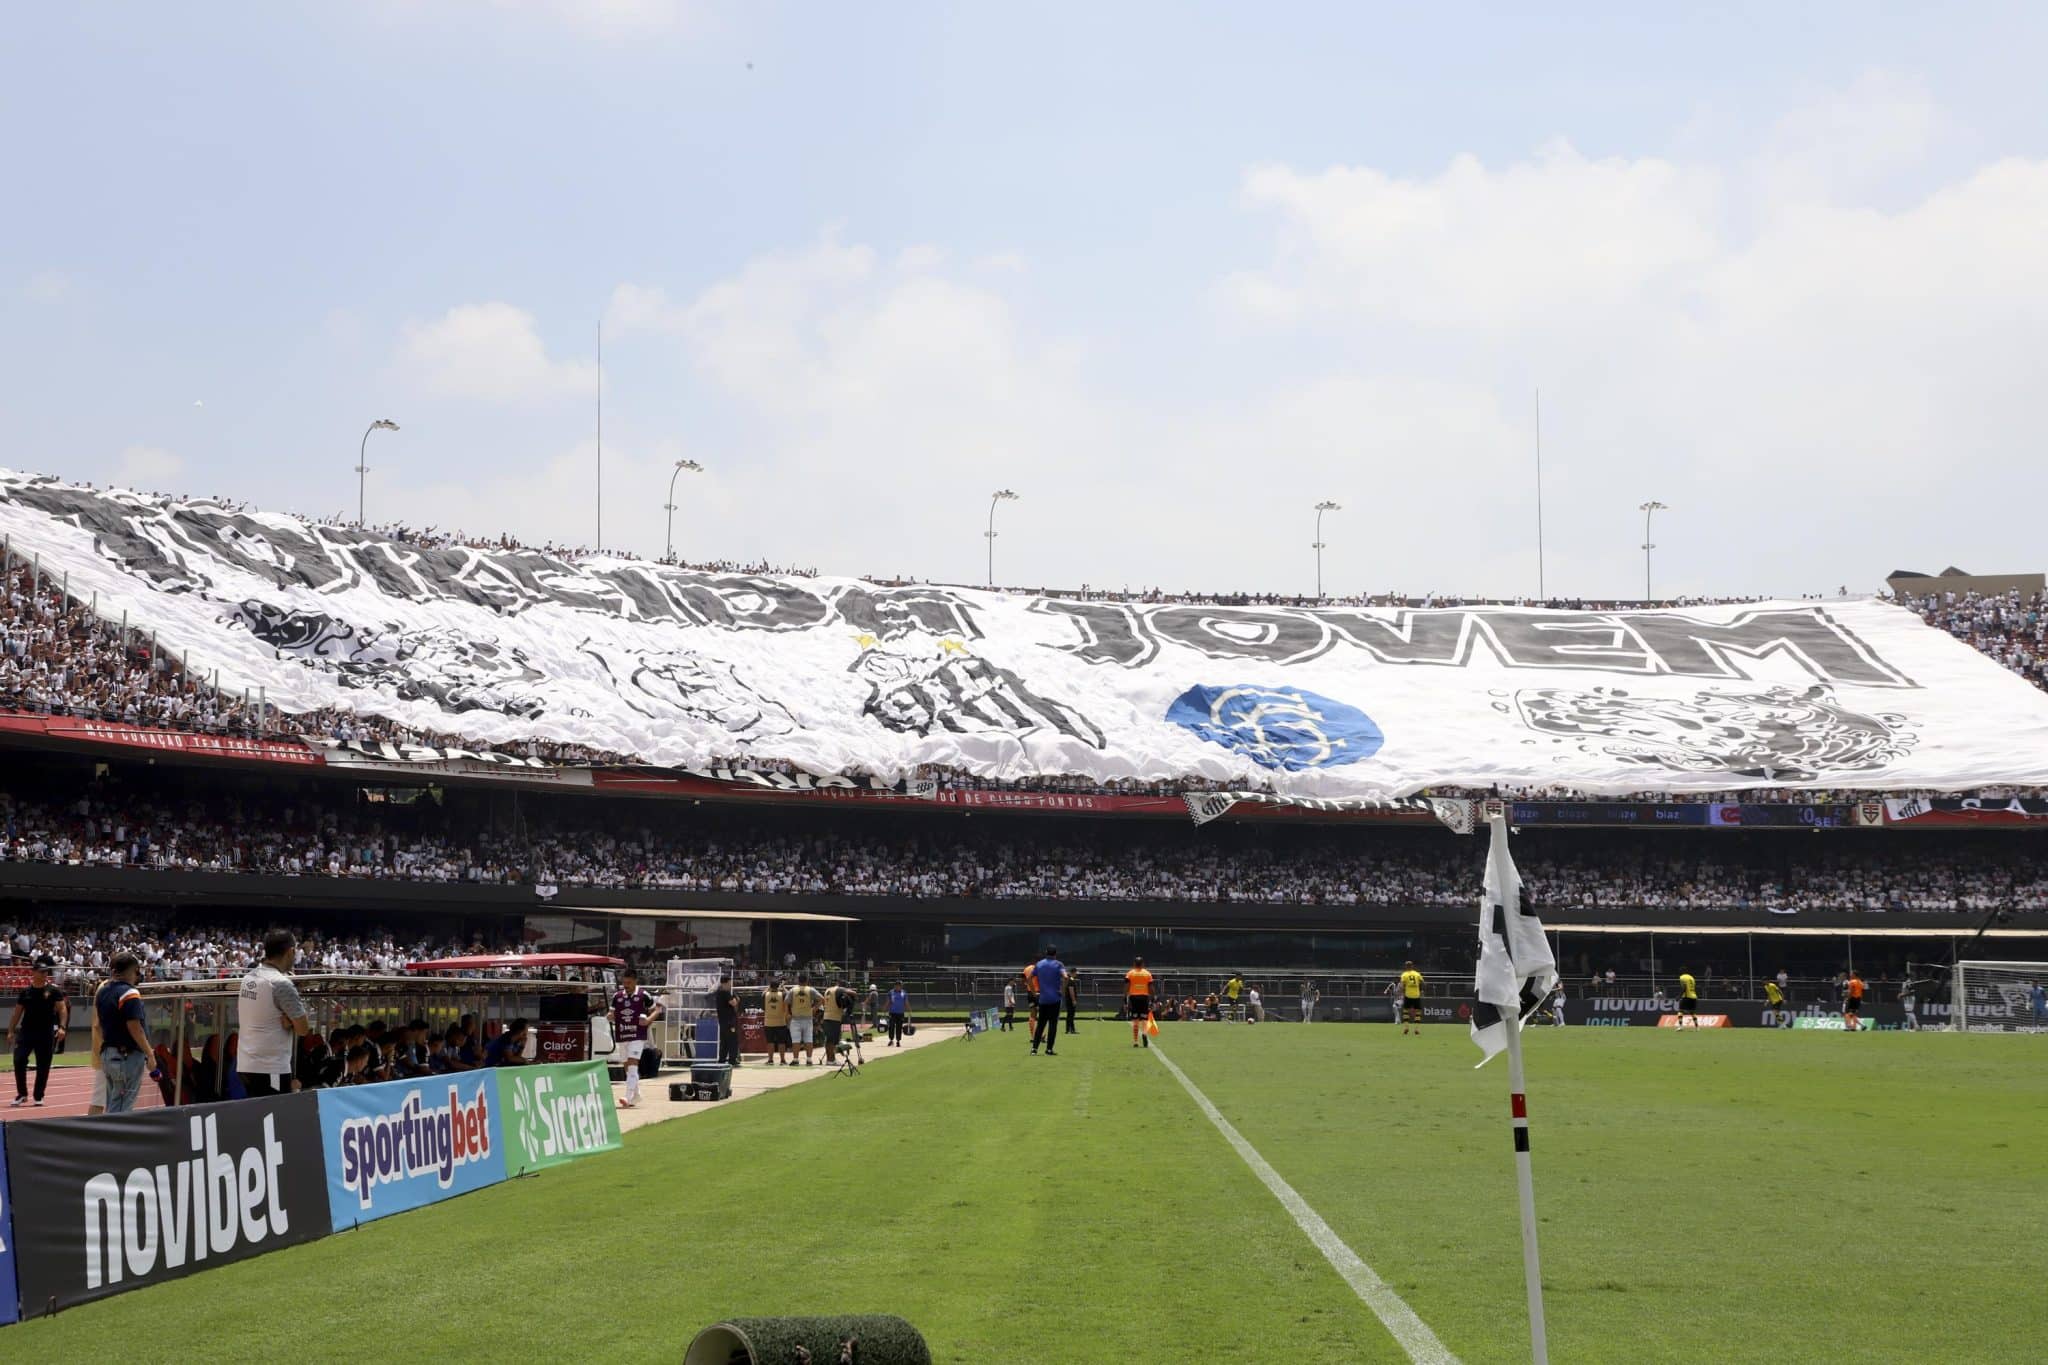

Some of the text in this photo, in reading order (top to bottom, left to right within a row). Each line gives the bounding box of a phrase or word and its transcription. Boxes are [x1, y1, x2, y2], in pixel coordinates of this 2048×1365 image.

[1030, 597, 1922, 689] JOVEM
[85, 723, 113, 740] MEU
[1040, 796, 1093, 808] PONTAS
[1424, 1007, 1452, 1016] blaze
[543, 1040, 572, 1051] Claro
[535, 1072, 608, 1156] Sicredi
[342, 1090, 489, 1204] sportingbet
[85, 1113, 289, 1289] novibet
